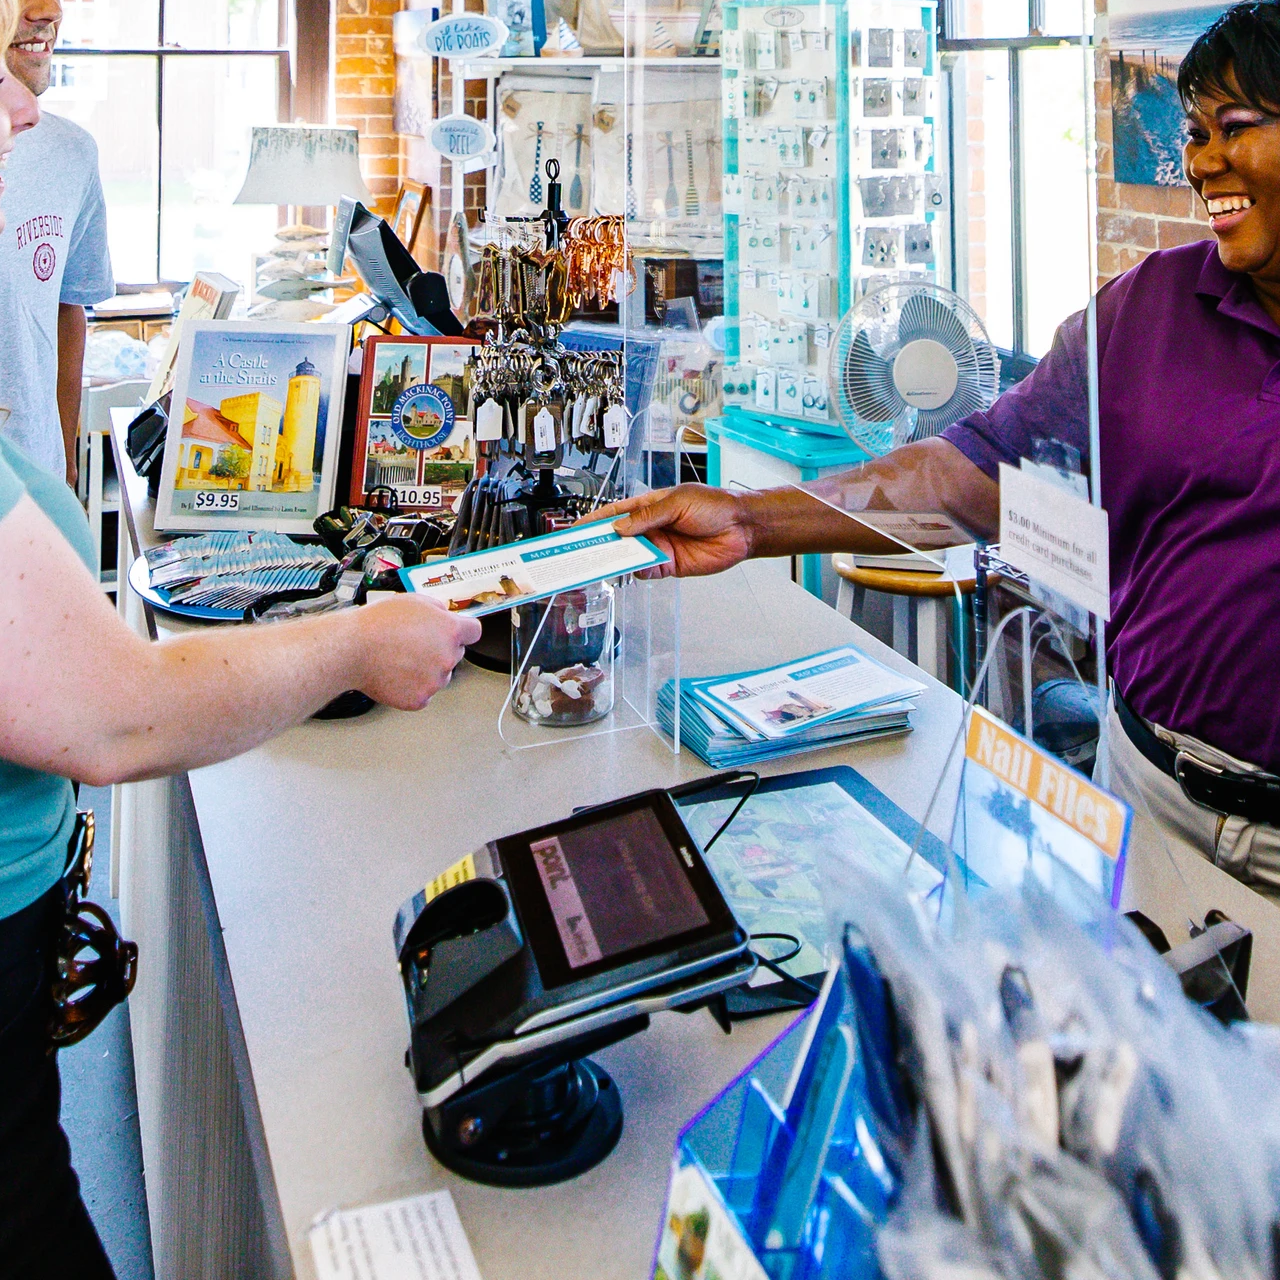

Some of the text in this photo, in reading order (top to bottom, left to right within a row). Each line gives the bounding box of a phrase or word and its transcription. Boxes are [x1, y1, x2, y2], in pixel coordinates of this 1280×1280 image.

[456, 31, 492, 51] BOATS
[15, 214, 64, 251] RIVERSIDE
[213, 351, 269, 369] A Castle
[199, 368, 278, 386] at the Straits
[392, 385, 455, 426] OLD MACKINAC POINT
[395, 429, 449, 451] LIGHTHOUSE
[195, 491, 239, 508] $9.95
[529, 549, 552, 560] MAP
[562, 534, 614, 554] SCHEDULE
[1008, 510, 1098, 566] $3.00 Minimum for all
[1008, 529, 1031, 549] credit
[1032, 542, 1050, 559] card
[976, 721, 1111, 844] Nail Files
